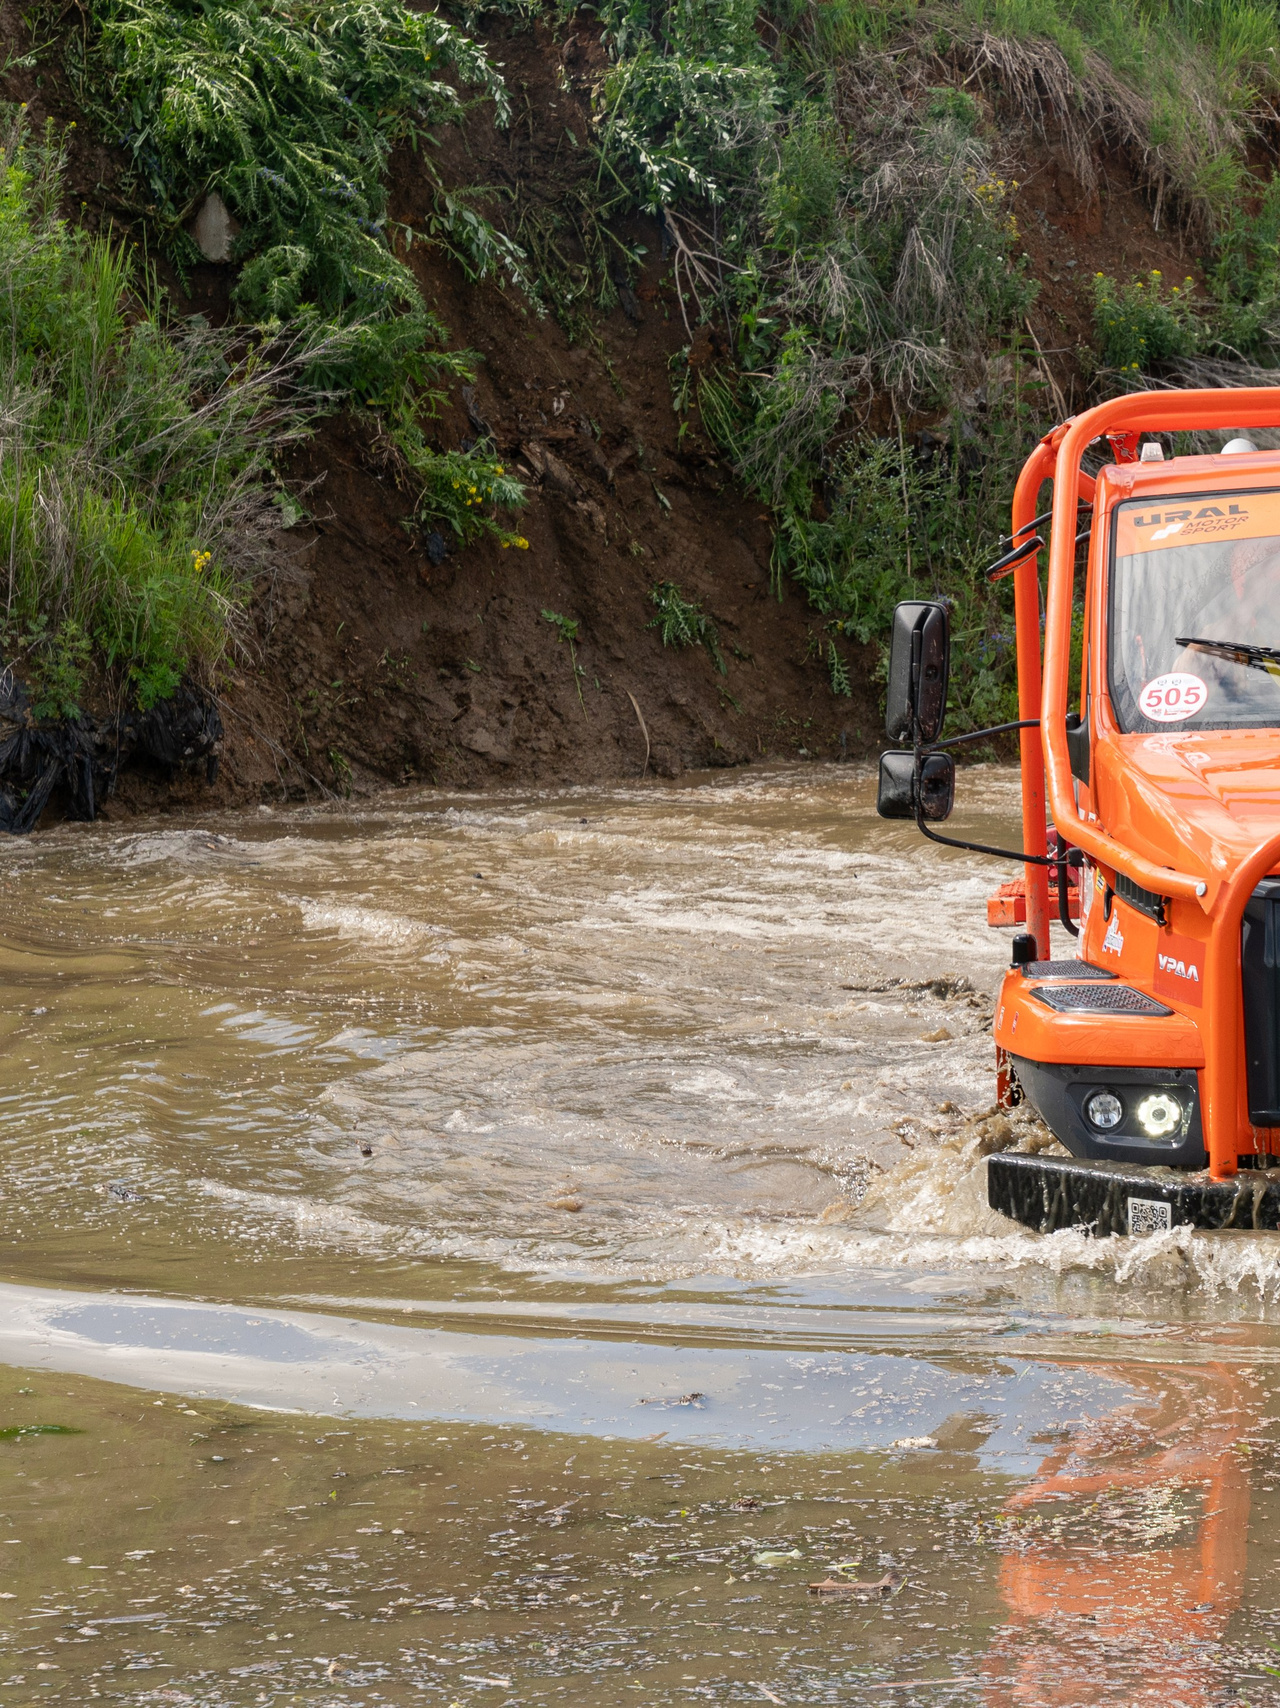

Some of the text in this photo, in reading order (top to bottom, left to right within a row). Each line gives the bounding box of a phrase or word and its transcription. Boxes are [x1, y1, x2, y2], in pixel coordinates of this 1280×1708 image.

[1134, 505, 1249, 527] URAL
[1186, 516, 1249, 528] MOTOR
[1180, 523, 1241, 536] SPORT
[1146, 686, 1201, 708] 505
[1158, 953, 1199, 982] УРАЛ
